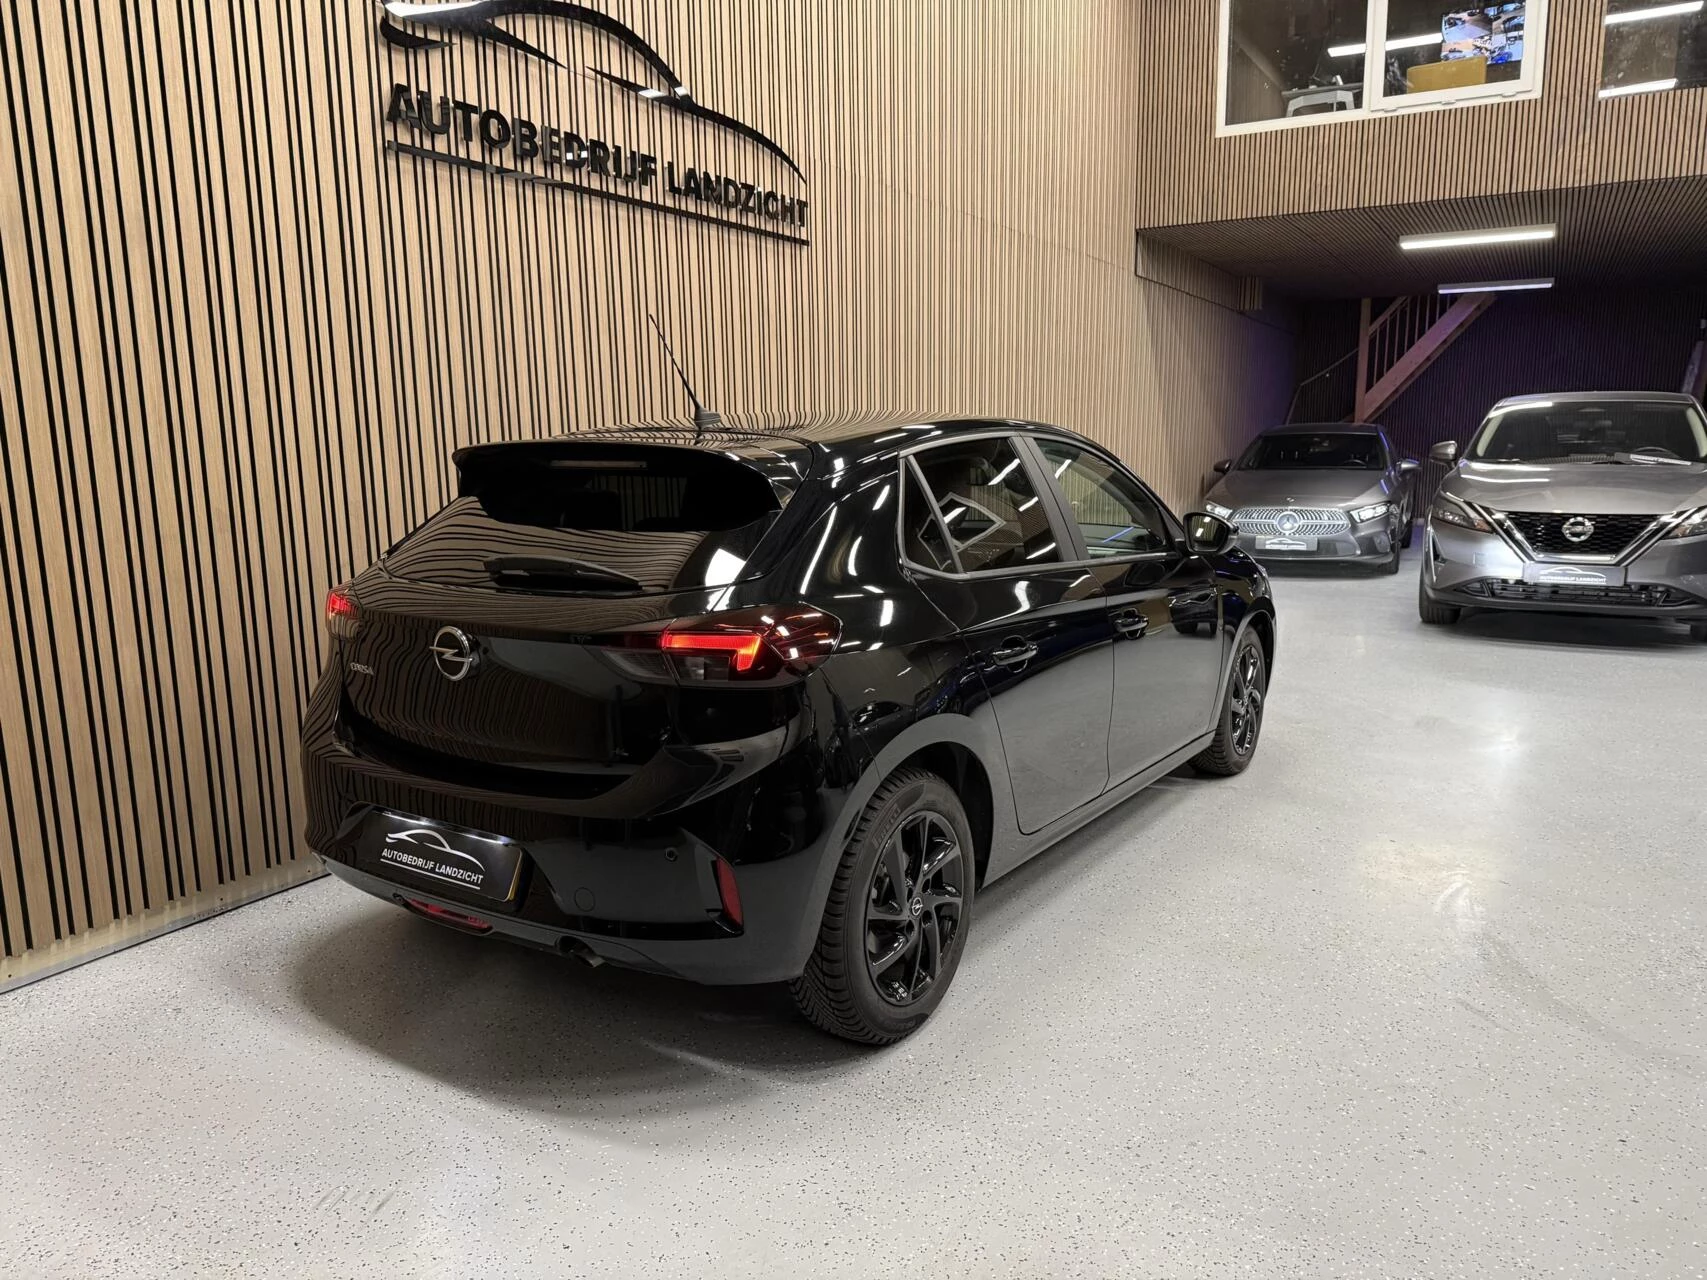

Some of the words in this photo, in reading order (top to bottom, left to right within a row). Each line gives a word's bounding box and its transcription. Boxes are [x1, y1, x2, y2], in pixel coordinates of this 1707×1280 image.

[386, 83, 657, 186] AUTOBEDRIJF
[666, 160, 809, 227] LANDZICHT
[381, 848, 434, 870] AUTOBEDRIJF
[435, 863, 483, 884] LANDZICHT
